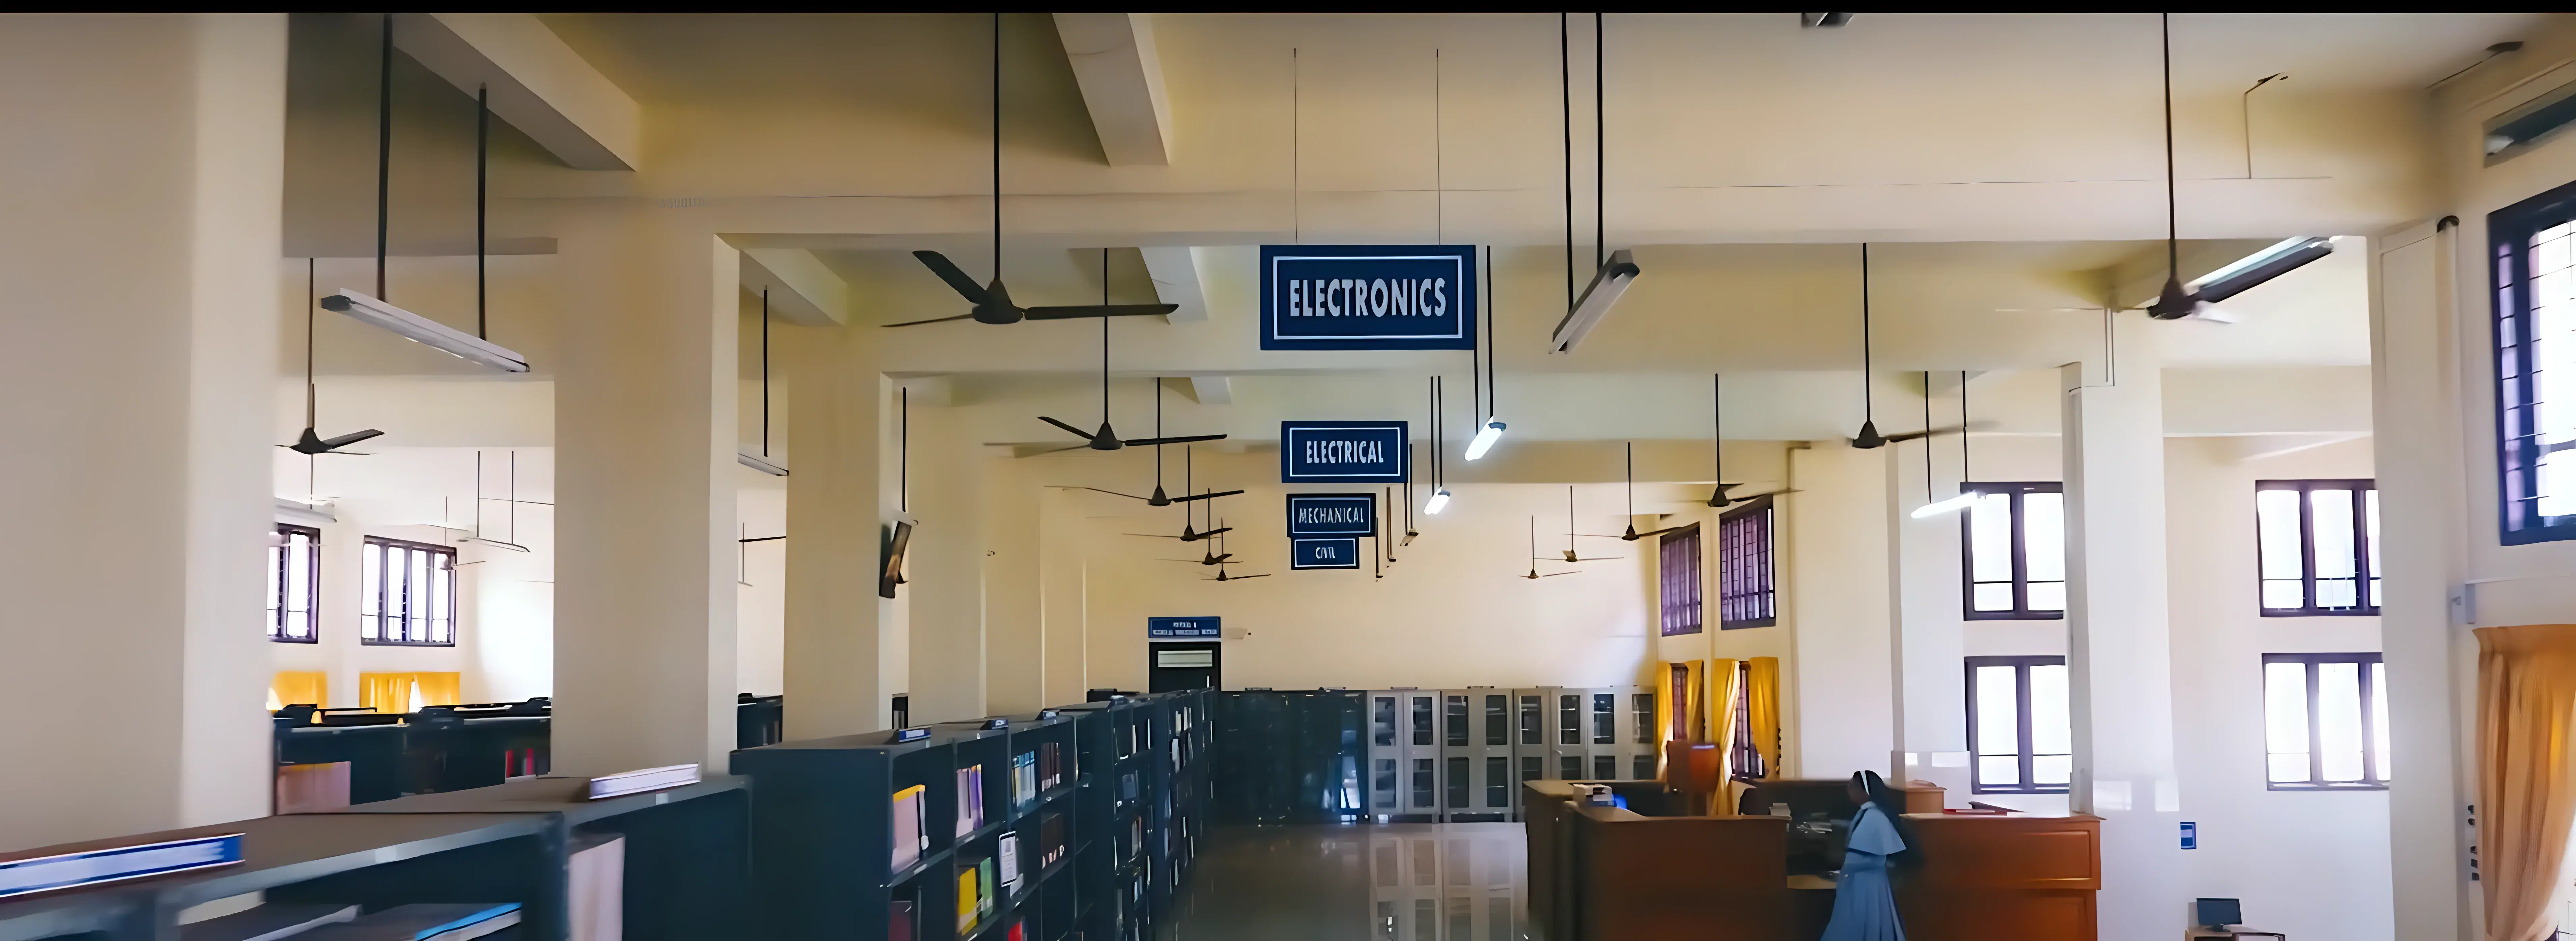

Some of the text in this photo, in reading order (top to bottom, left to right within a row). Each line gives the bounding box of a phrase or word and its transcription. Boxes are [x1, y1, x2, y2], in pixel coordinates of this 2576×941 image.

[1290, 278, 1446, 317] ELECTRONICS
[1307, 440, 1384, 463] ELECTRICAL
[1299, 507, 1364, 523] MECHANICAL
